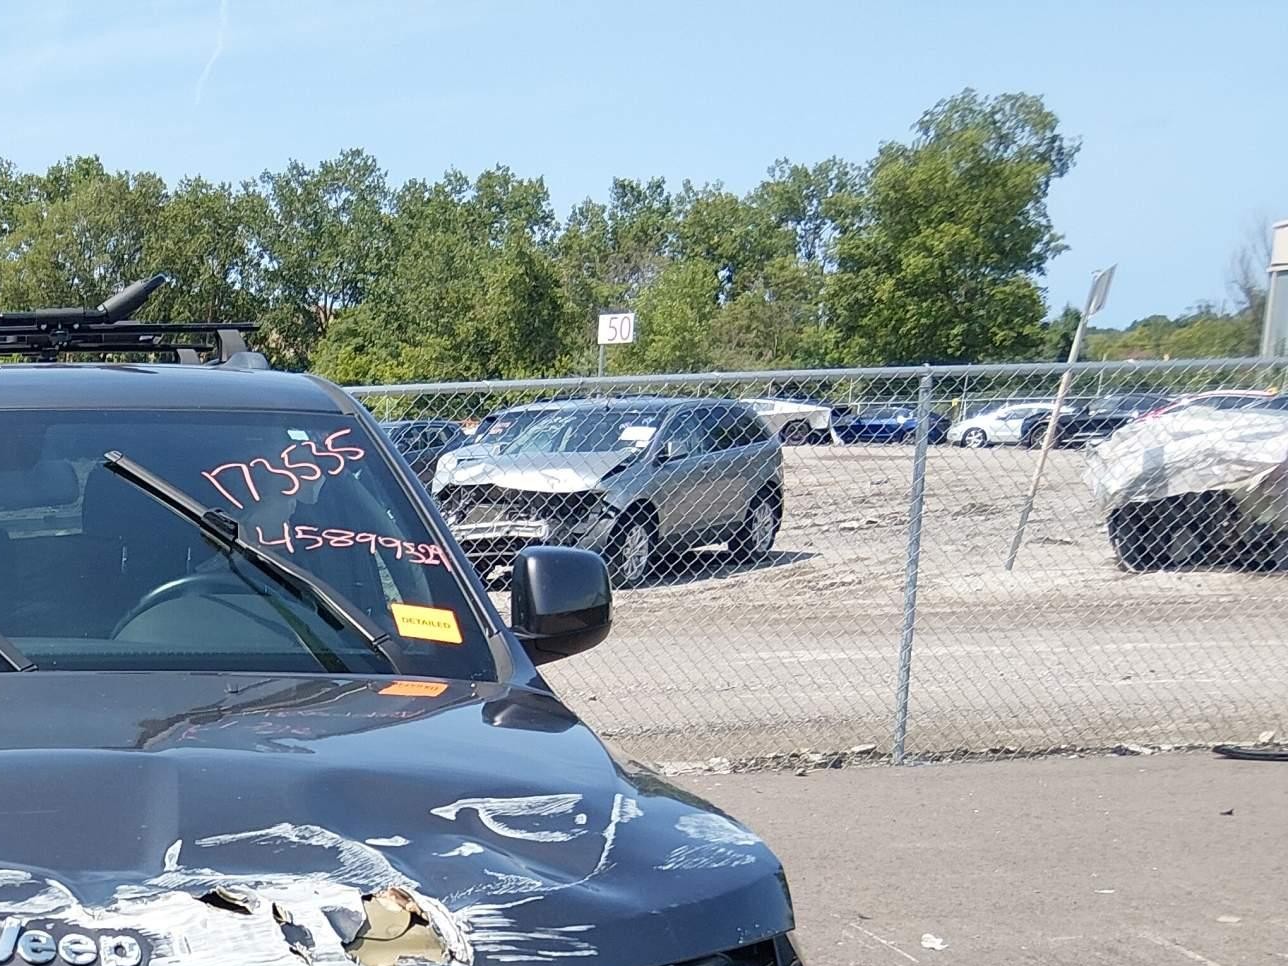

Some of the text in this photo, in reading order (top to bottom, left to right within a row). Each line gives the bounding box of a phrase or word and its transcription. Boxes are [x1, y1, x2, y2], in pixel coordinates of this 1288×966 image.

[607, 316, 631, 341] 50
[255, 521, 452, 572] 45899529
[400, 616, 452, 629] DETAILED
